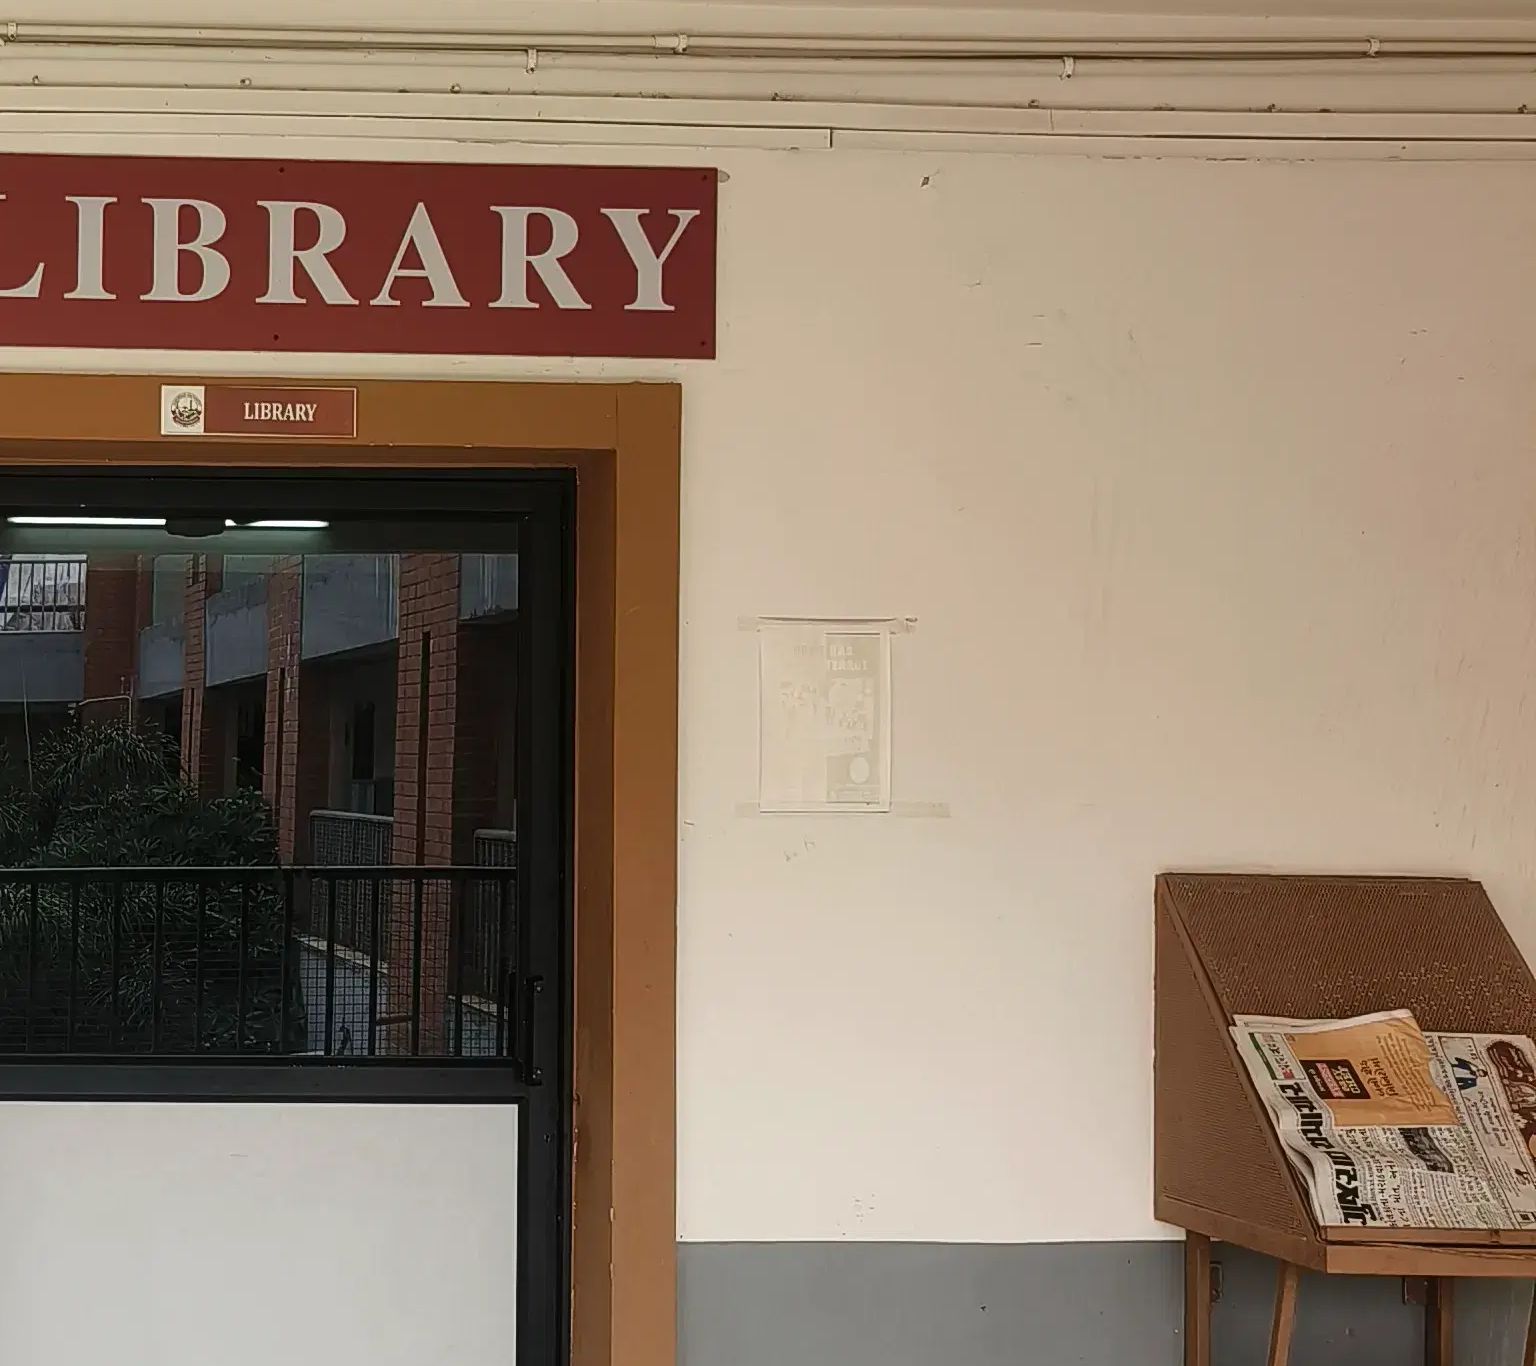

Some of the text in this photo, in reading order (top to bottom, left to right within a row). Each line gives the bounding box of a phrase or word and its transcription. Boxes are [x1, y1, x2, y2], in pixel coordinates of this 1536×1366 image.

[244, 402, 317, 422] LIBRARY
[1277, 1082, 1333, 1148] સમાચાર
[1329, 1151, 1376, 1224] ગુજરાત
